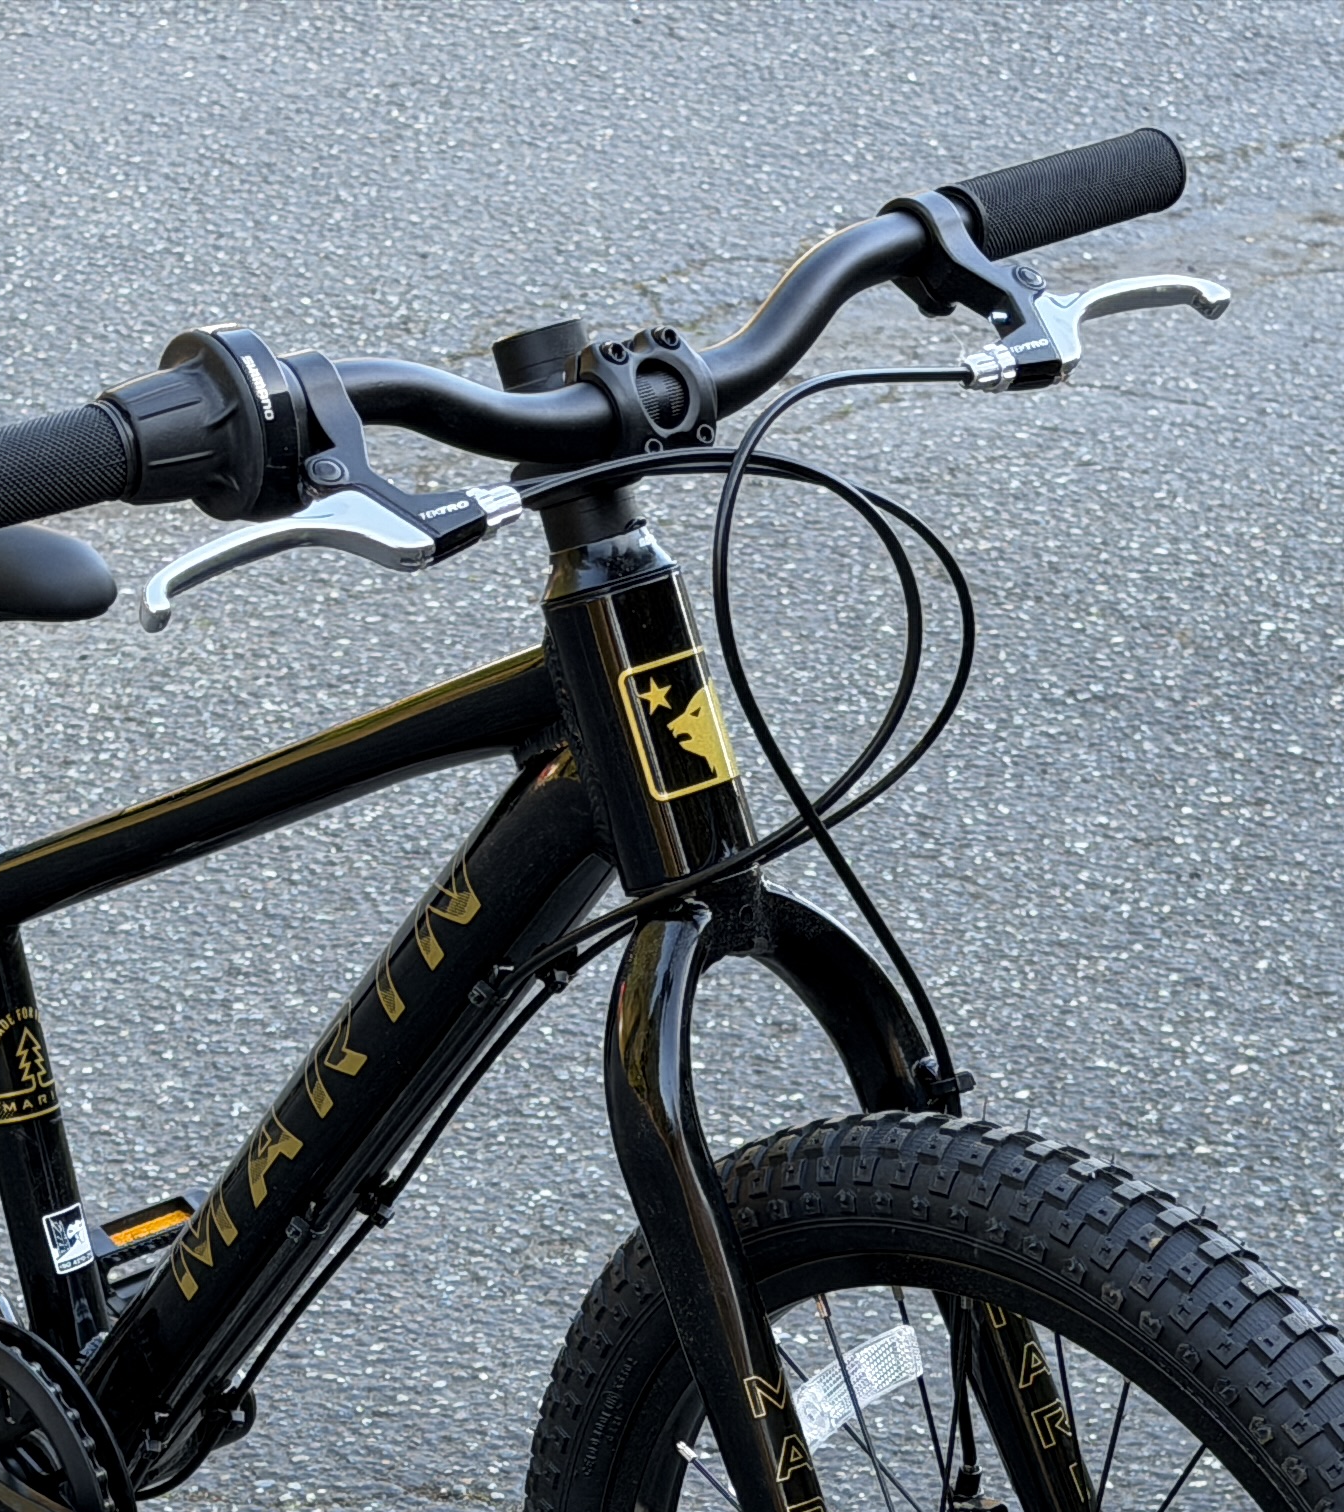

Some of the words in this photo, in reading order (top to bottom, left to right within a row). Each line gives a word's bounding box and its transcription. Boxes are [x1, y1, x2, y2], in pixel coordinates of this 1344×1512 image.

[240, 355, 274, 421] SHIMANO
[418, 500, 470, 520] TEKTRO
[15, 1006, 35, 1021] FOR
[170, 837, 482, 1301] MARIN
[2, 1090, 56, 1114] MARI
